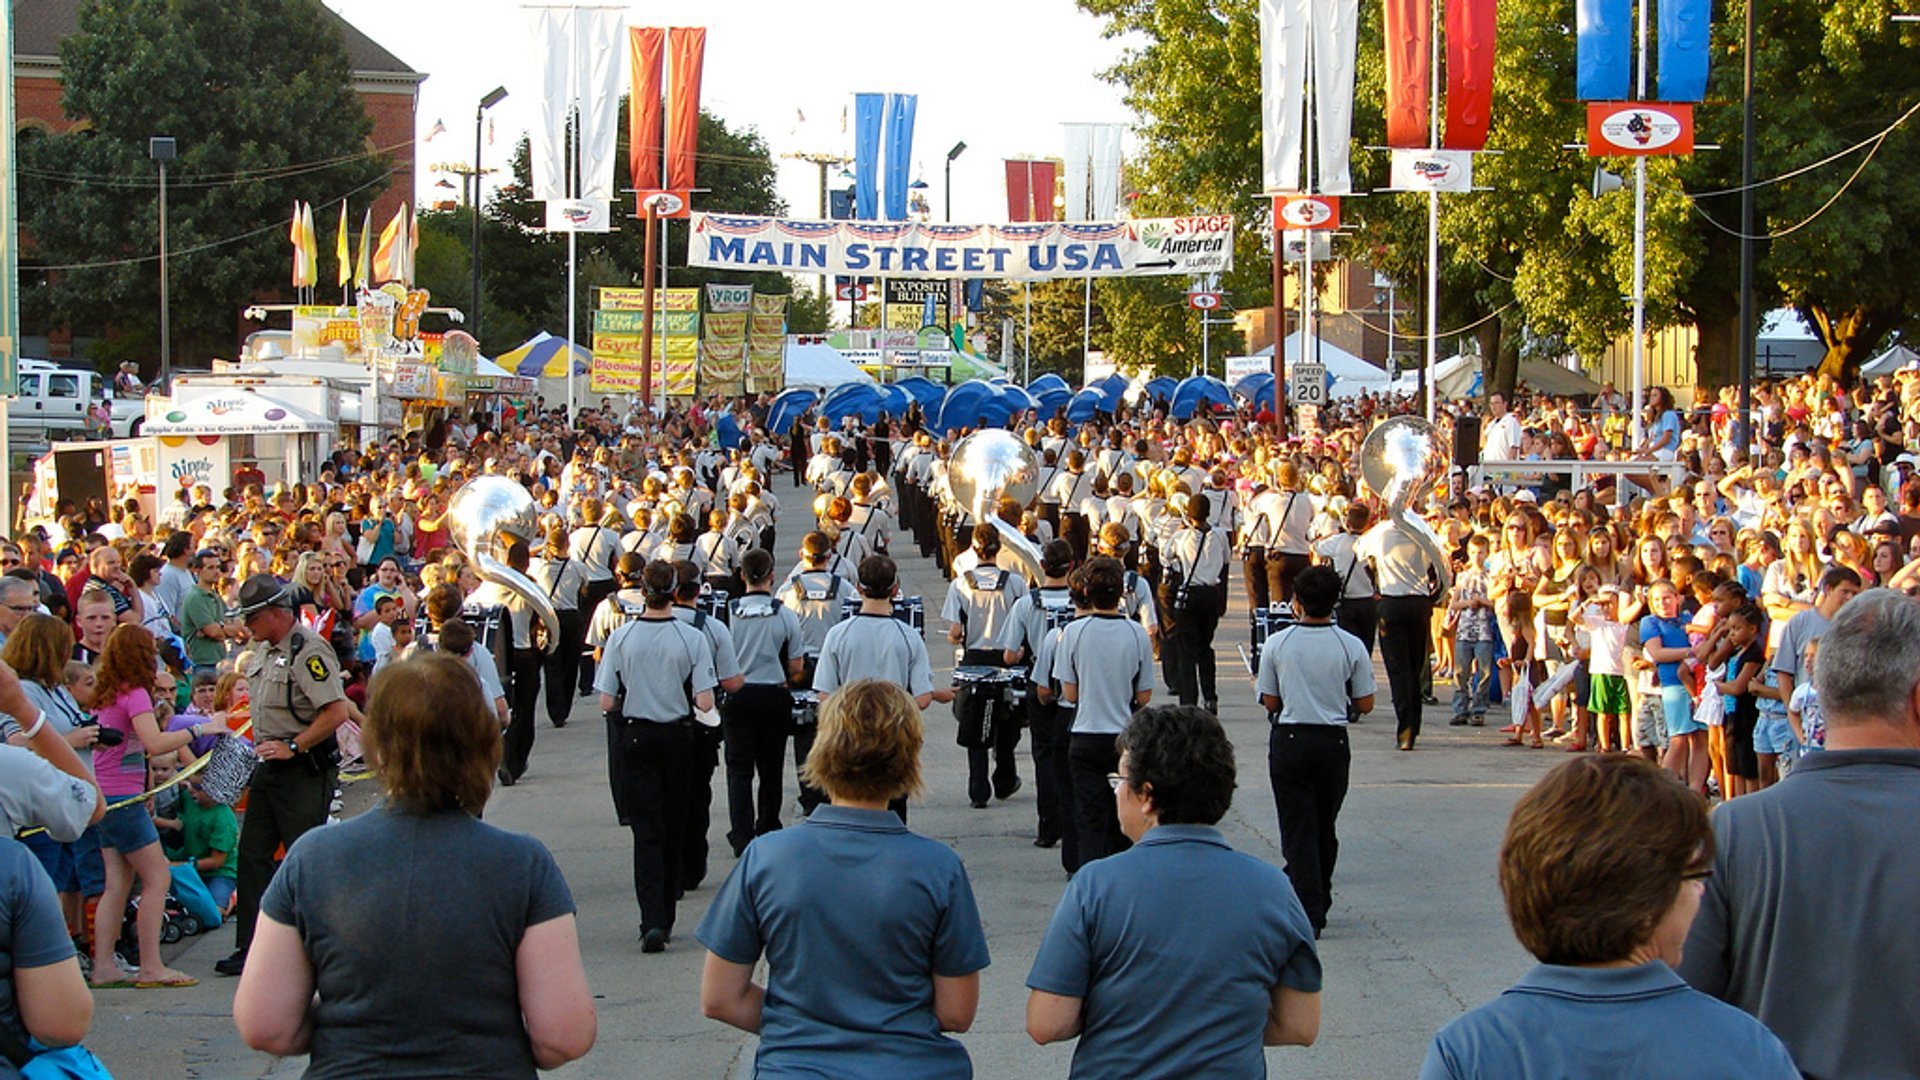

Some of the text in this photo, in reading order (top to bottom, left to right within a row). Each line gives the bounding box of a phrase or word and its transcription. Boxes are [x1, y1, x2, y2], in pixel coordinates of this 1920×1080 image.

[1174, 215, 1230, 235] STAGE
[708, 236, 1124, 272] MAIN STREET USA
[1160, 237, 1223, 254] Ameren
[890, 280, 948, 293] EXPOSITI
[320, 327, 360, 345] PRETZE
[1297, 384, 1320, 401] 20
